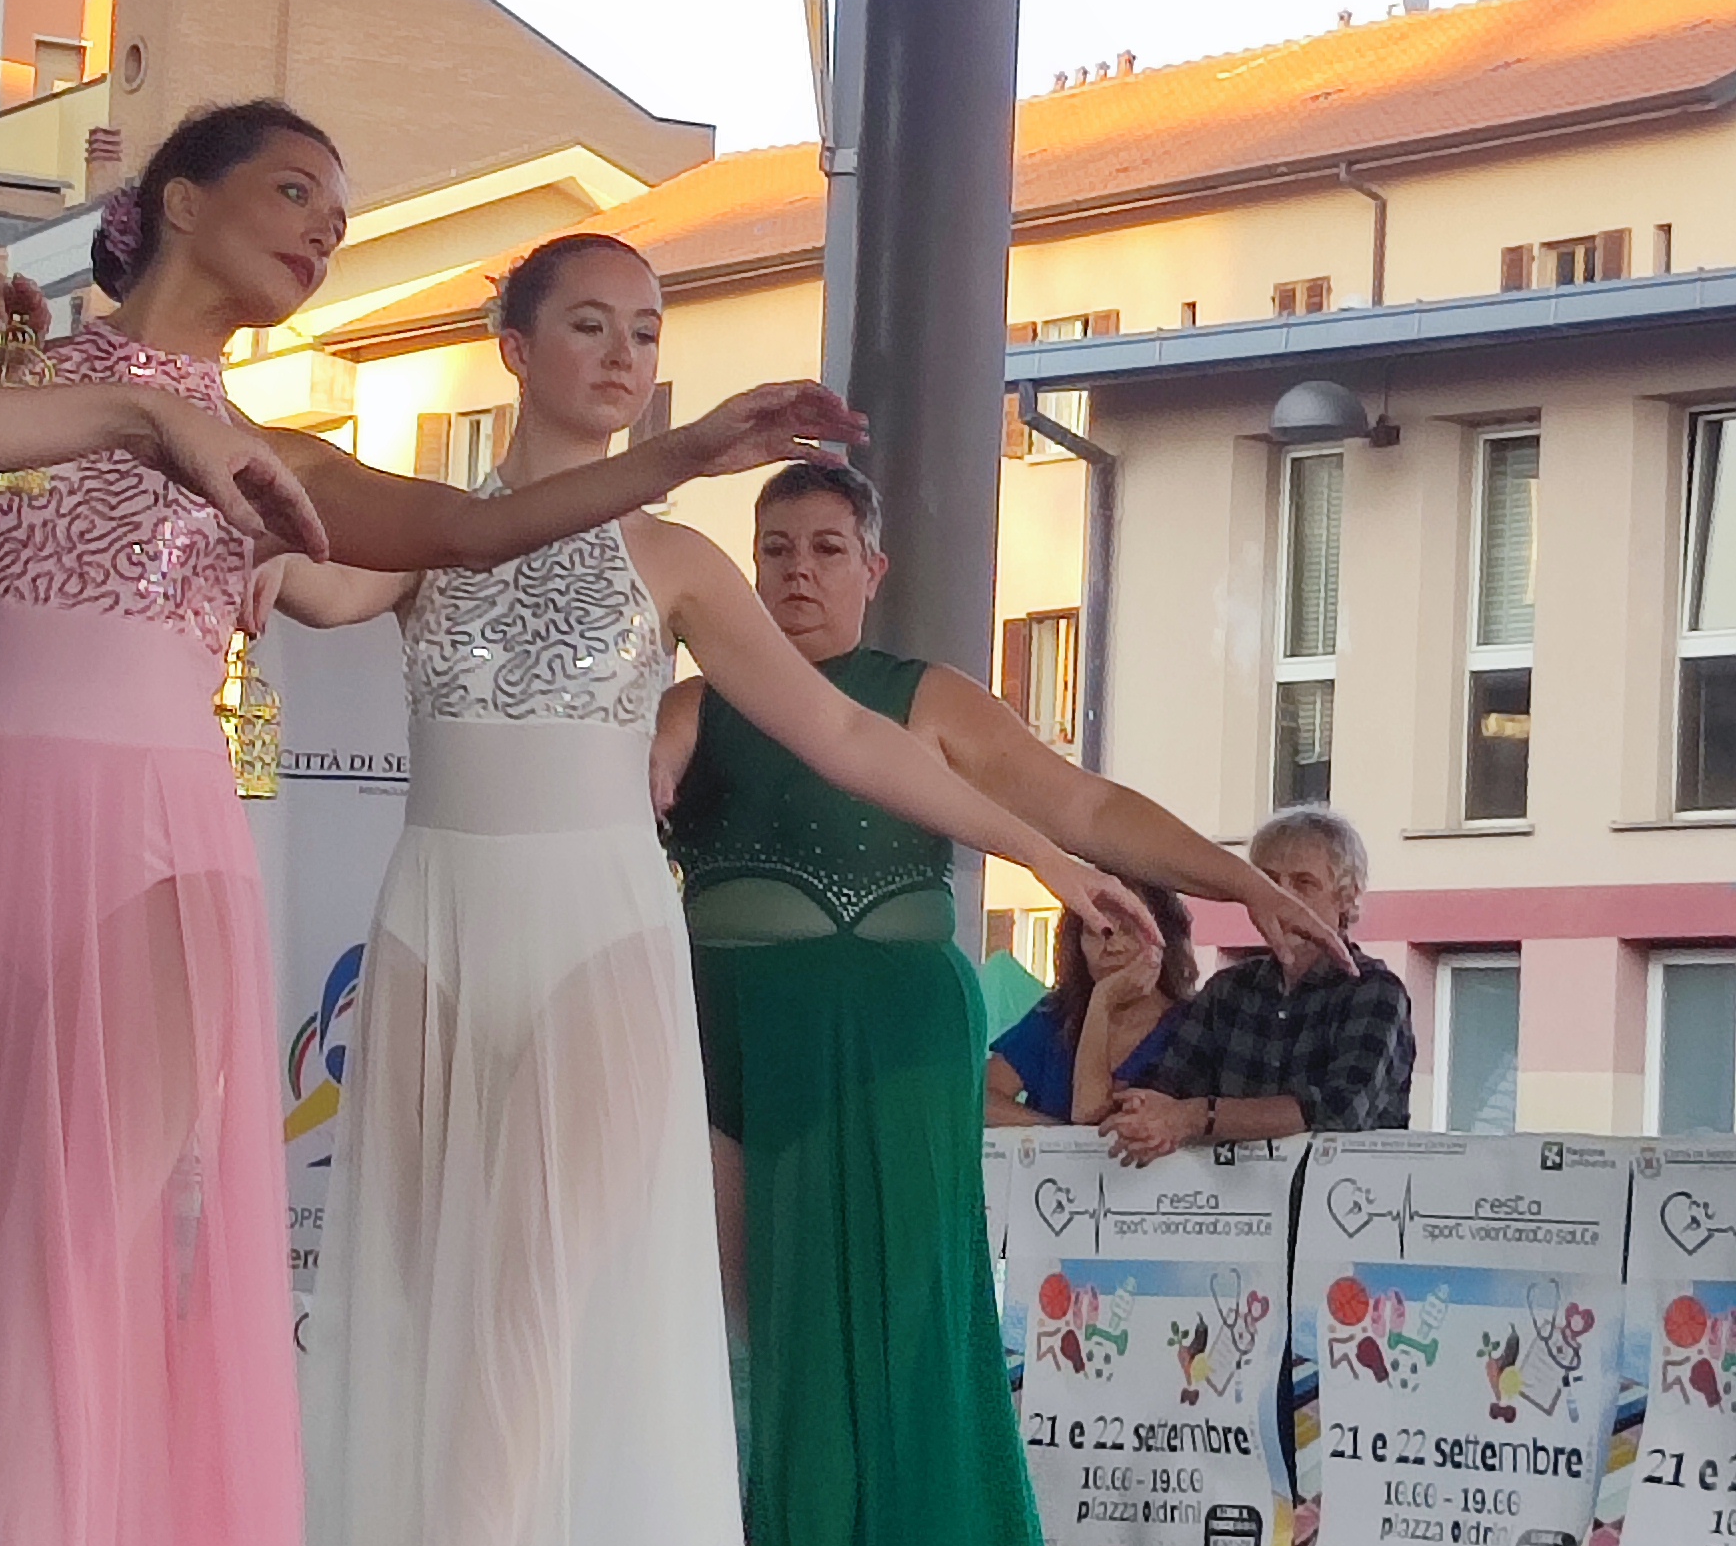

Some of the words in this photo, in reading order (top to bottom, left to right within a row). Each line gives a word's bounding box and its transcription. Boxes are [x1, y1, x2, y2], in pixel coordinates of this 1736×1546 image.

[349, 754, 374, 772] DI
[1027, 1412, 1060, 1448] 21
[1068, 1419, 1086, 1449] e
[1092, 1415, 1125, 1451] 22
[1132, 1417, 1252, 1456] settembre
[1328, 1422, 1363, 1461] 21
[1371, 1431, 1388, 1463] e
[1394, 1428, 1427, 1466] 22
[1433, 1432, 1584, 1479] settembre
[1080, 1465, 1133, 1492] 10.00
[1150, 1467, 1204, 1494] 19.00
[1641, 1447, 1686, 1489] 21
[1698, 1458, 1719, 1491] e
[1076, 1497, 1138, 1524] piazza
[1383, 1479, 1438, 1509] 10.00
[1460, 1487, 1522, 1517] 19.00
[1379, 1512, 1445, 1541] piazza
